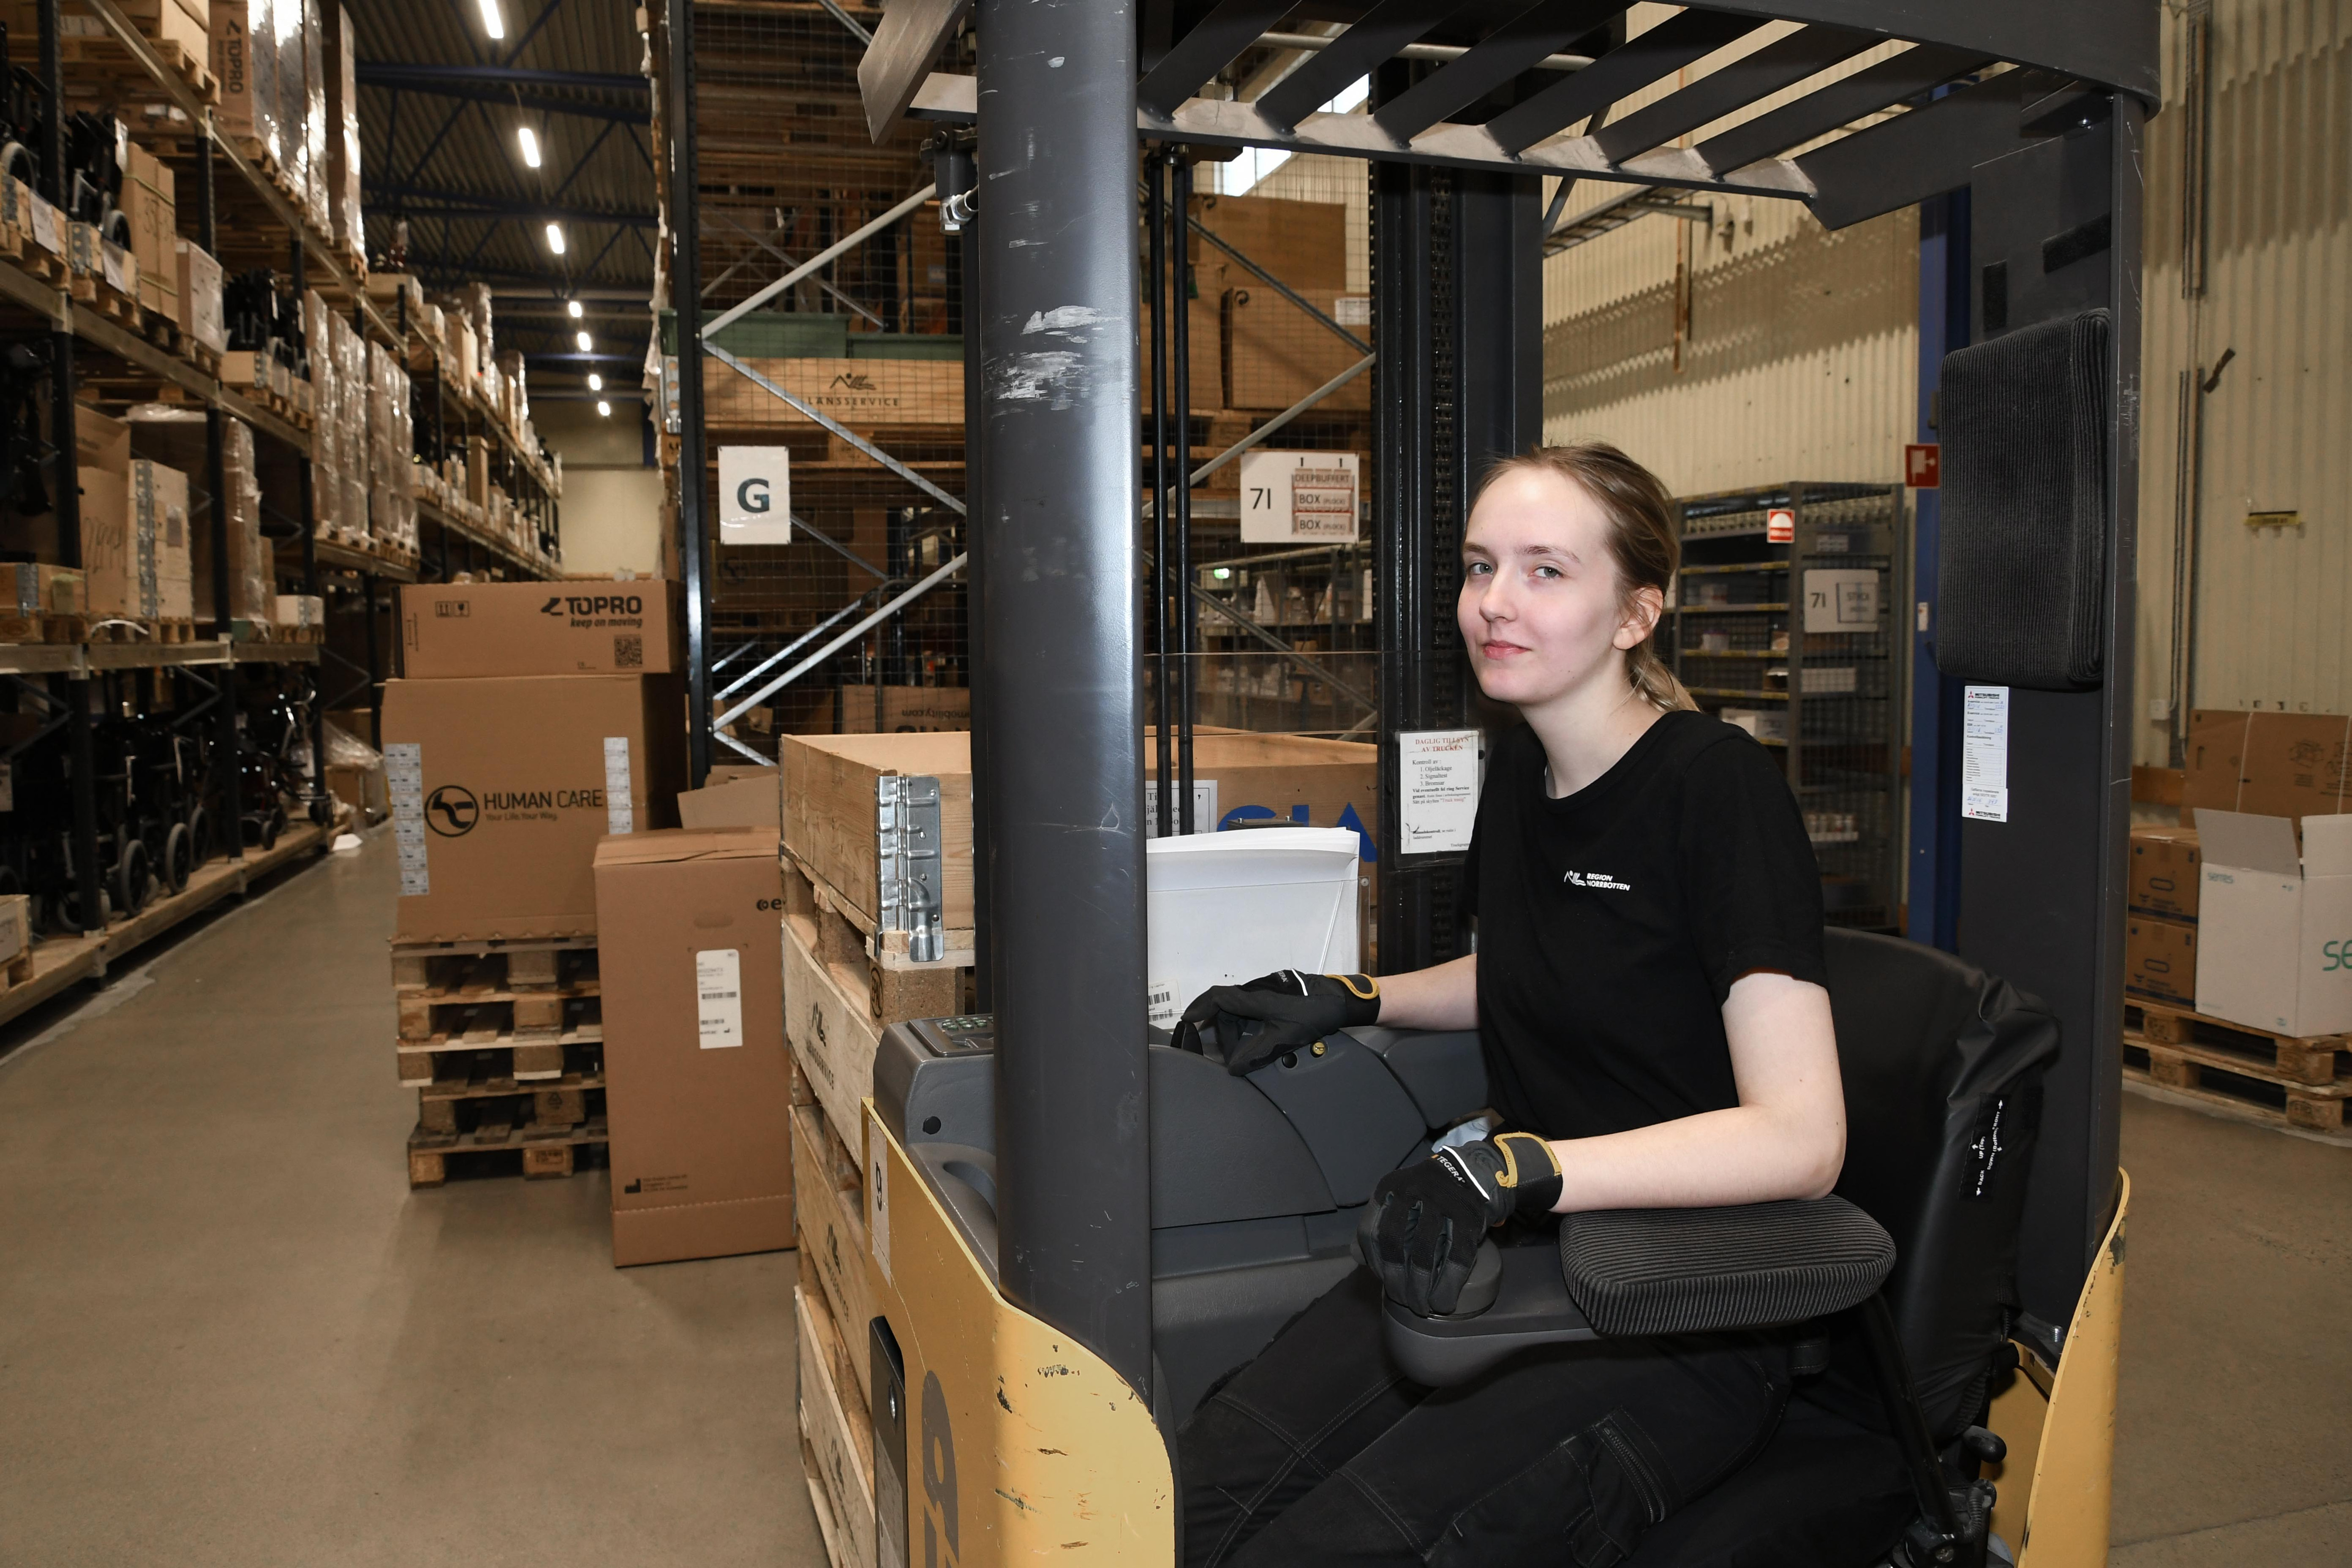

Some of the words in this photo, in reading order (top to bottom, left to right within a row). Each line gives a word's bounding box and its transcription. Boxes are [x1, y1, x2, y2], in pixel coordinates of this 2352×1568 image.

[228, 38, 243, 94] TOPRO
[737, 477, 770, 513] G
[1250, 488, 1271, 509] 71
[1299, 494, 1320, 504] BOX
[1300, 519, 1321, 530] BOX
[565, 596, 642, 615] TOPRO
[571, 617, 593, 629] keep
[594, 619, 606, 627] on
[608, 616, 642, 629] moving
[484, 791, 551, 810] HUMAN
[557, 789, 603, 808] CARE
[485, 813, 502, 822] Your
[1586, 873, 1613, 882] REGION
[1586, 880, 1631, 891] NORRBOTTEN
[1979, 1151, 1984, 1159] UP
[1987, 1152, 1995, 1170] DOWN
